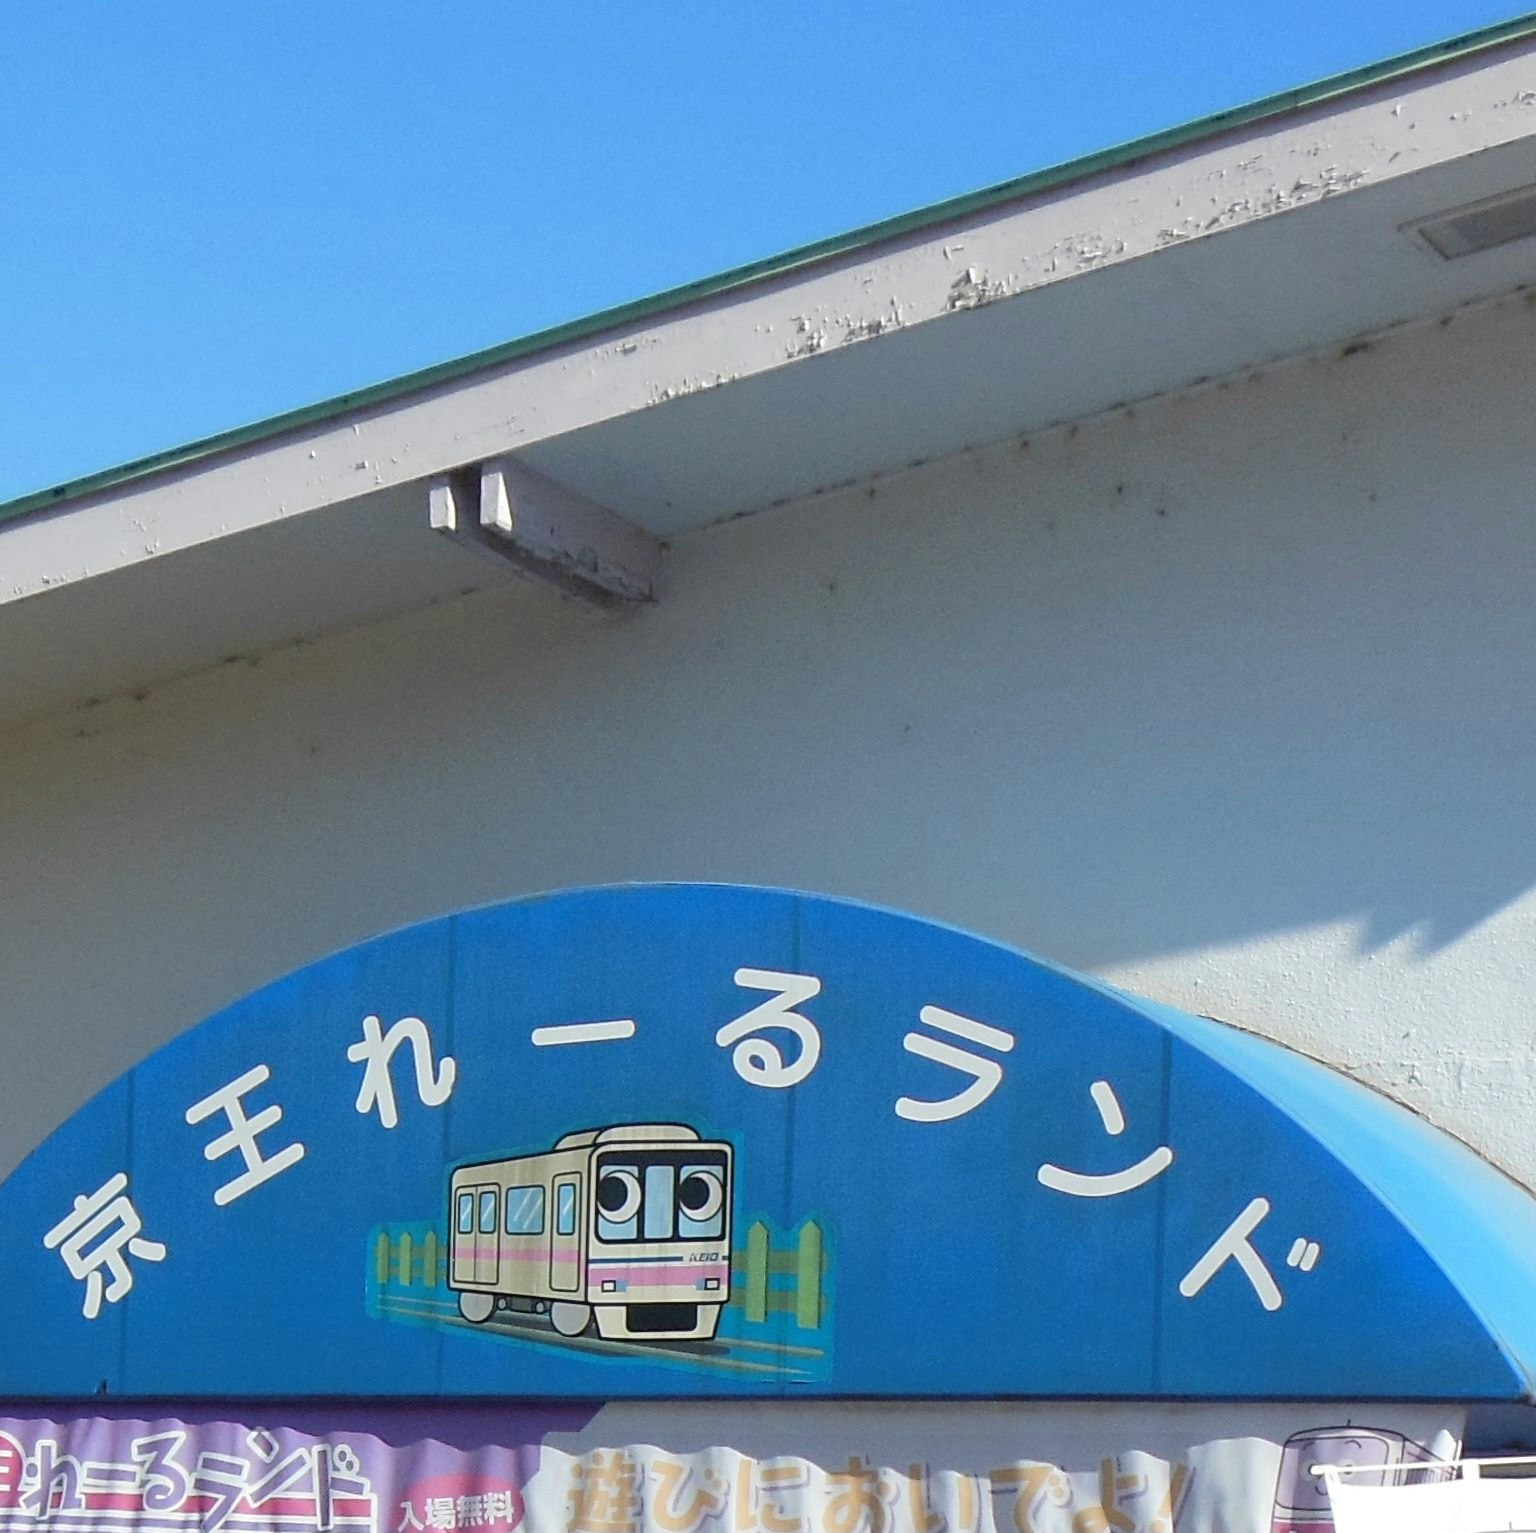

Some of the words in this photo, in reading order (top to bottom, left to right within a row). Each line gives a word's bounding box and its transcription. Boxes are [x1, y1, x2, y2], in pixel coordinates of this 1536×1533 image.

[43, 966, 1320, 1318] 京王れーるランド
[689, 1251, 720, 1262] KEIO
